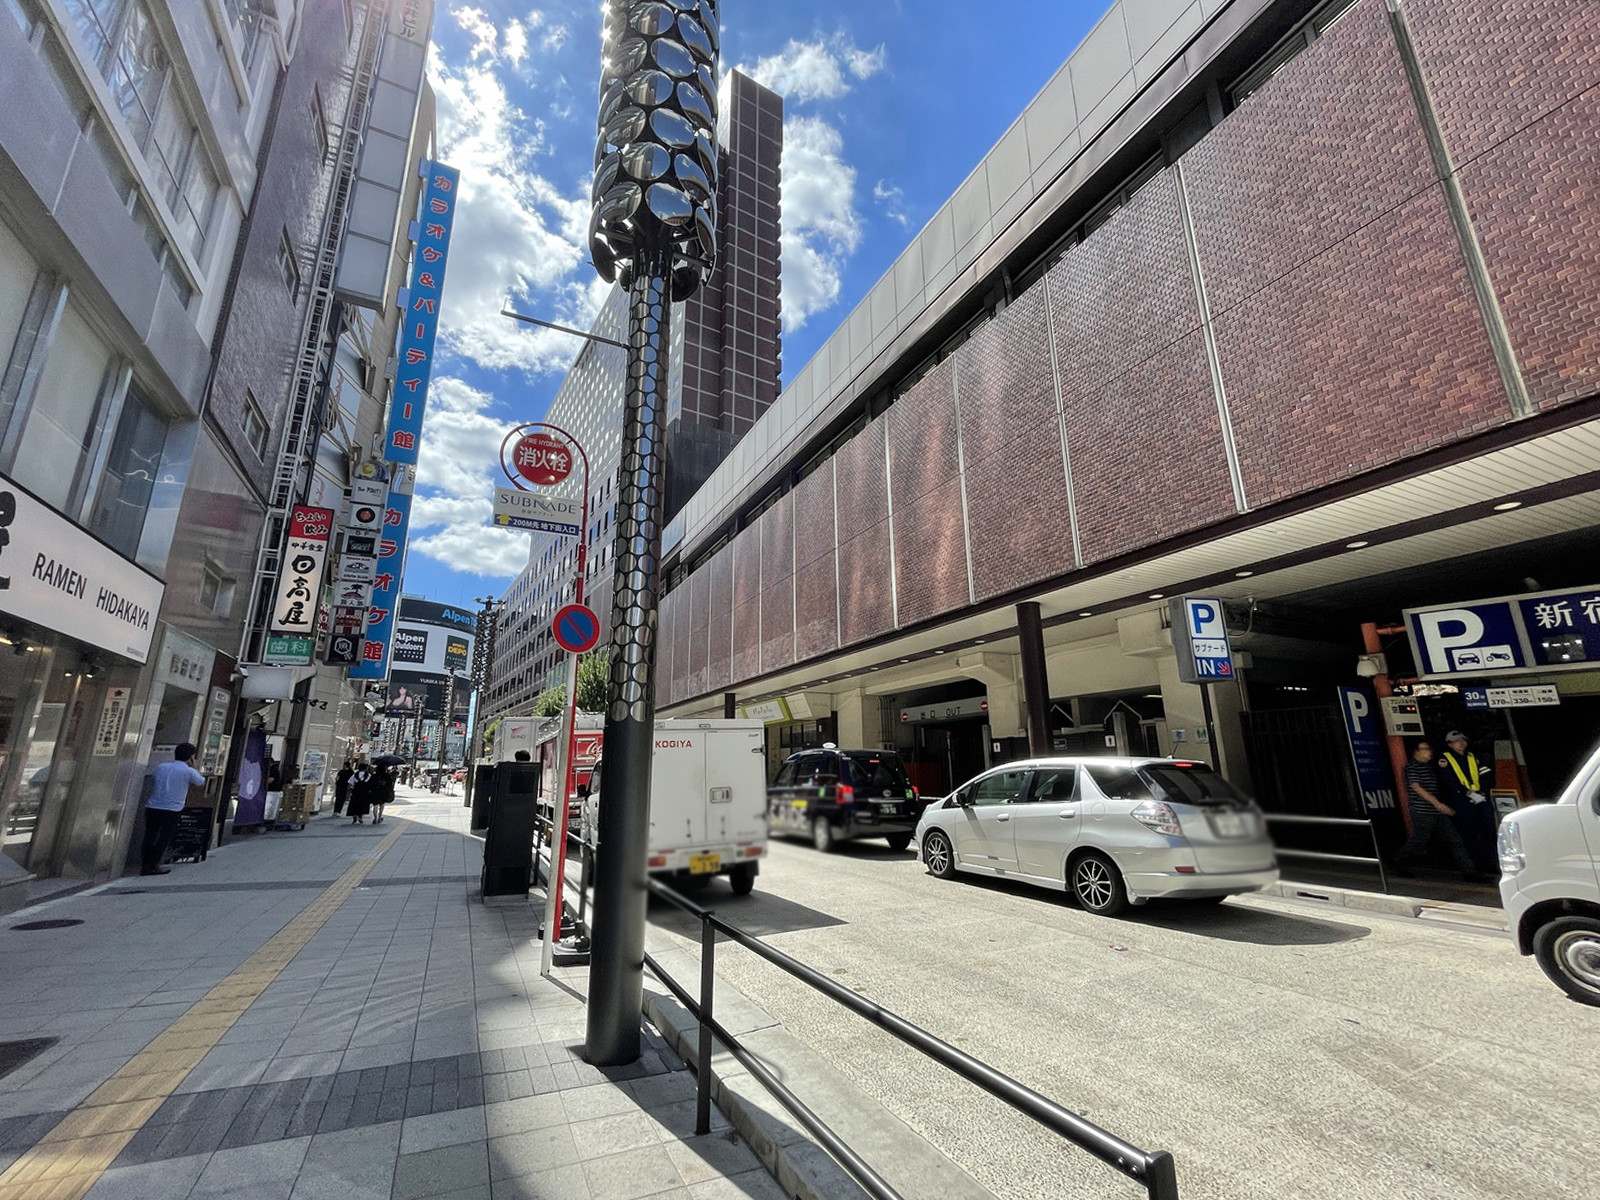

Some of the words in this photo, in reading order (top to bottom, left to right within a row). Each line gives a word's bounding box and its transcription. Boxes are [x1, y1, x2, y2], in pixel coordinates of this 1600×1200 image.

[524, 437, 538, 445] FIRE
[538, 440, 564, 449] HYDRANT
[518, 445, 569, 473] 消火栓
[500, 493, 577, 514] SUBNADE
[295, 511, 327, 522] ちょい
[303, 524, 328, 535] 飲み
[512, 518, 540, 529] 200M先
[540, 521, 576, 534] 地下街入口
[32, 552, 87, 599] RAMEN
[96, 586, 150, 630] HIDAKAYA
[278, 554, 317, 625] 日高屋
[1191, 603, 1215, 634] P
[395, 633, 425, 643] Alpen
[1418, 608, 1485, 673] P
[270, 640, 308, 653] 歯科
[394, 641, 424, 651] Outdoors
[447, 646, 467, 656] DEPO
[1194, 643, 1226, 653] サブナード
[1196, 659, 1216, 675] IN
[946, 706, 961, 717] OUT
[1346, 691, 1369, 733] P
[655, 740, 692, 748] KOGIYA
[1377, 789, 1395, 808] IN
